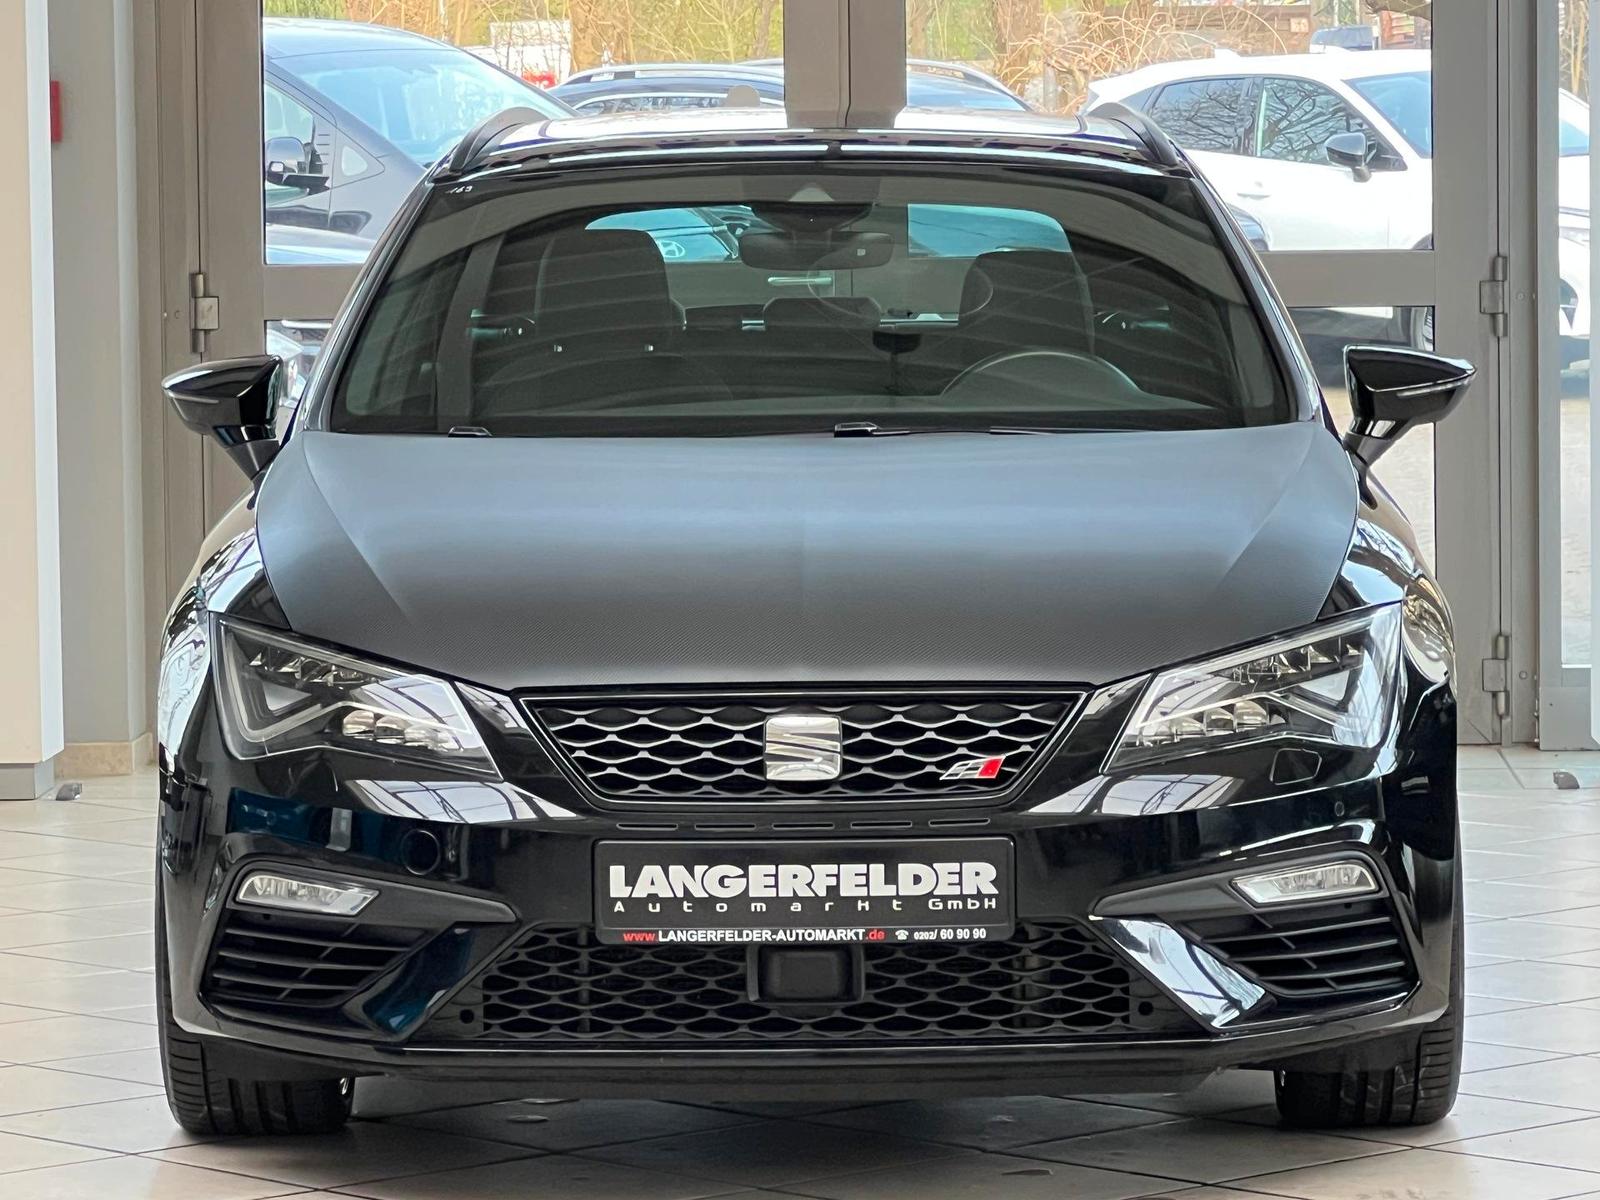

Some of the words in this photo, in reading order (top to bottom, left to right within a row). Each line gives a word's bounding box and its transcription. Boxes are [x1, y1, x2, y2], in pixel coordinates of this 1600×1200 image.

[609, 862, 999, 898] LANGERFELDER
[928, 898, 997, 911] GmbH
[941, 929, 954, 941] 60
[956, 928, 971, 940] 90
[973, 928, 987, 940] 90
